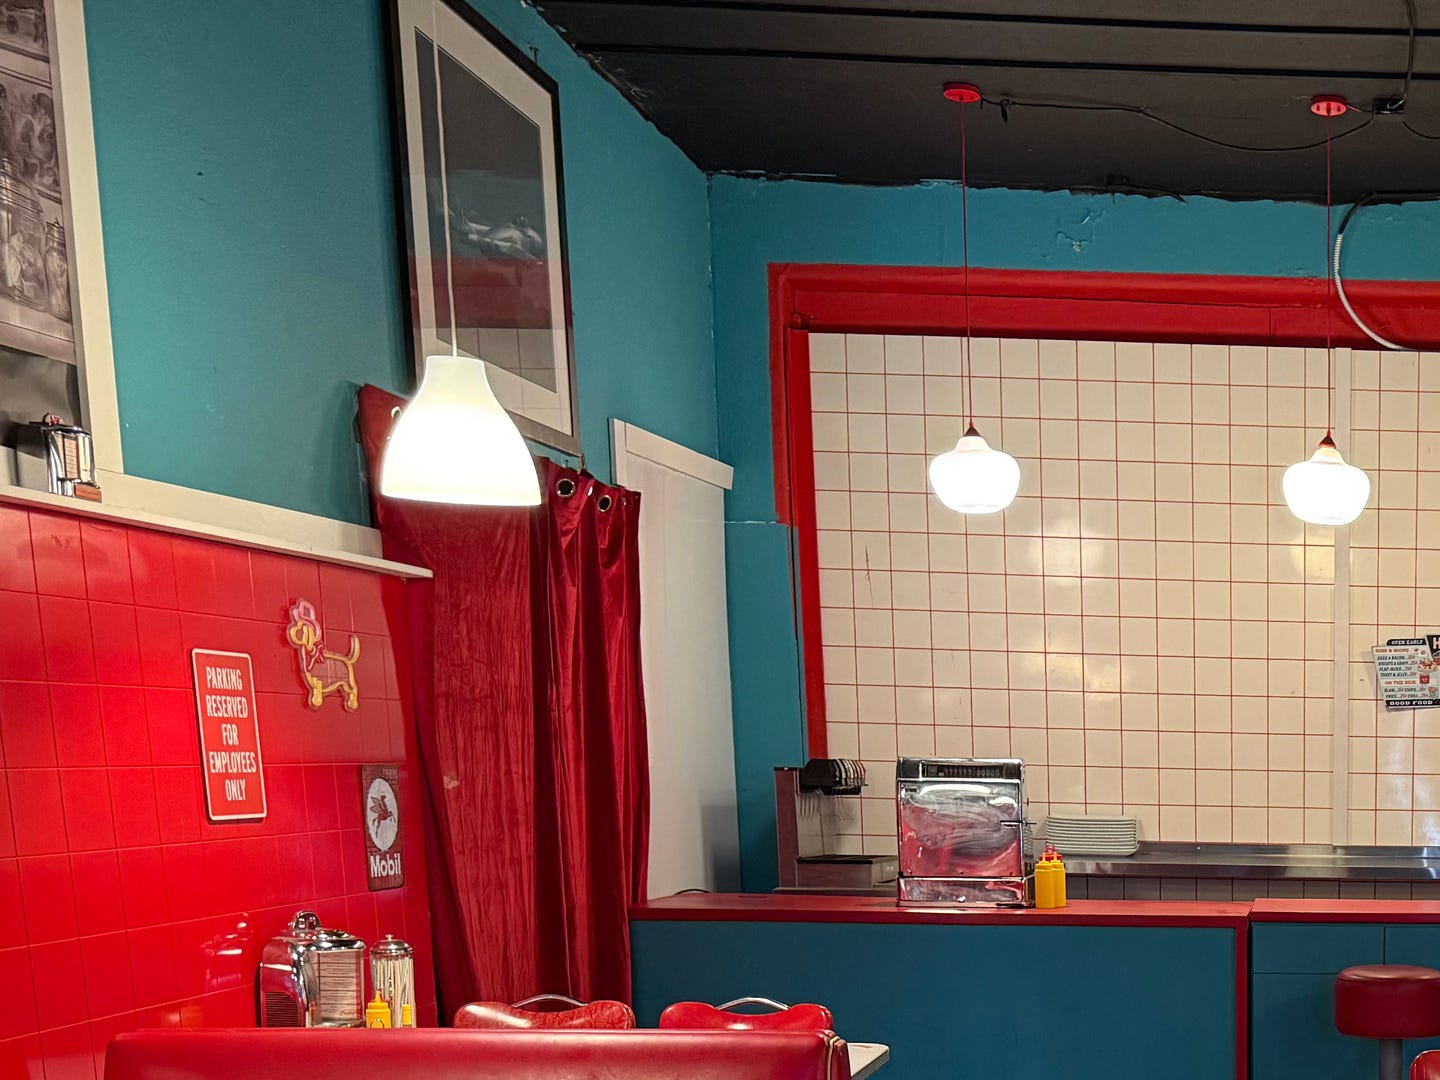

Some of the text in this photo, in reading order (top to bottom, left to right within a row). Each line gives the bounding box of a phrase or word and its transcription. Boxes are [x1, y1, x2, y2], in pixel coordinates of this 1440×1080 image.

[206, 666, 243, 691] PARKING
[205, 694, 248, 719] RESERVED
[221, 723, 240, 746] FOR
[209, 751, 257, 774] EMPLOYEES
[225, 778, 247, 801] ONLY
[369, 852, 401, 878] Mobil
